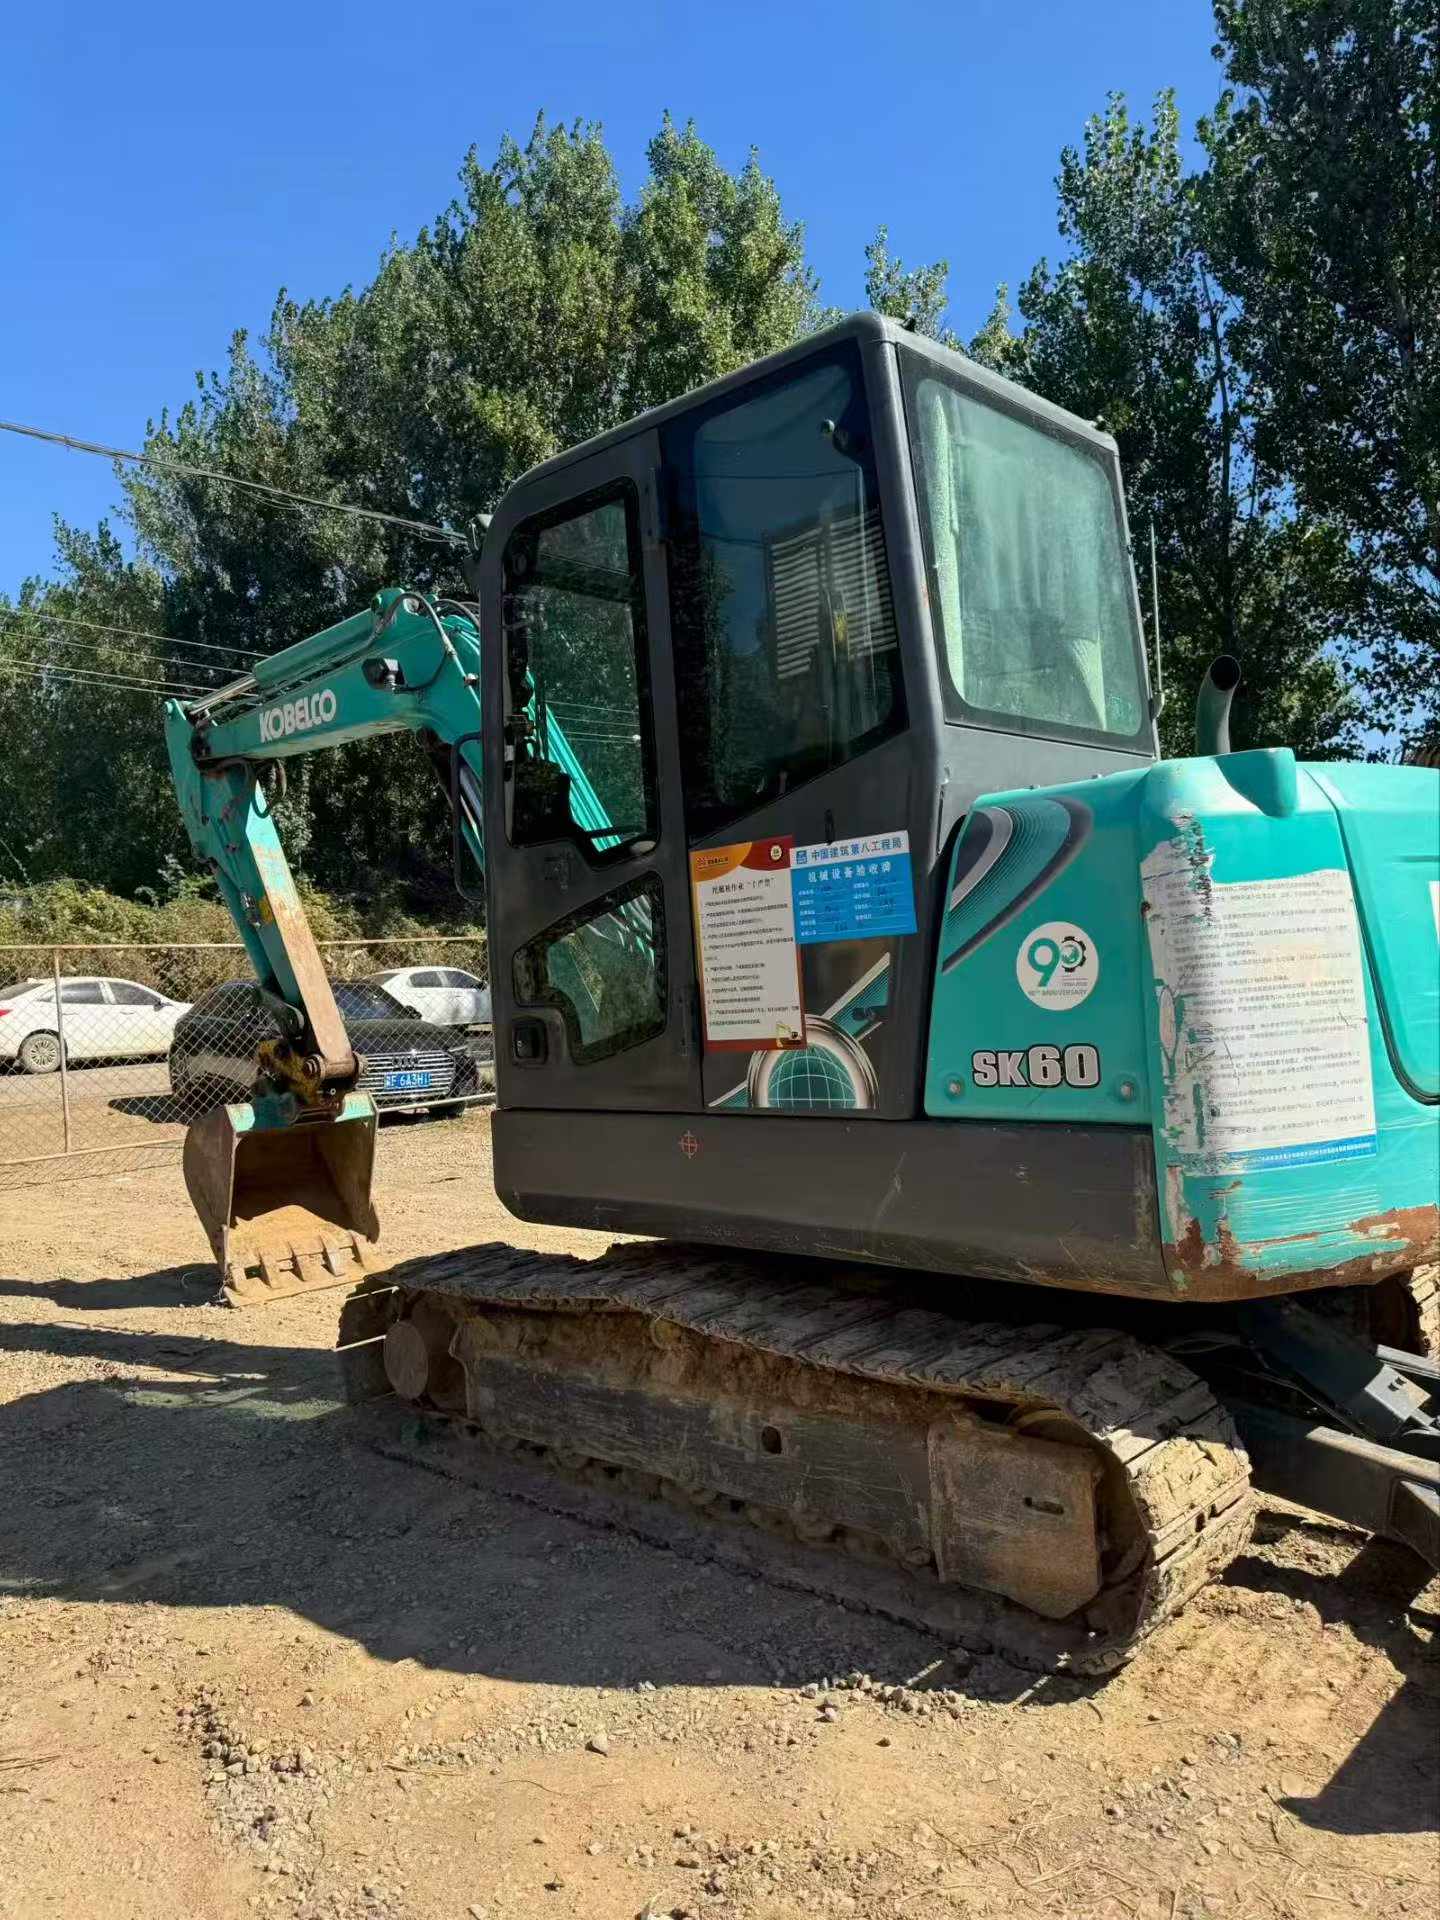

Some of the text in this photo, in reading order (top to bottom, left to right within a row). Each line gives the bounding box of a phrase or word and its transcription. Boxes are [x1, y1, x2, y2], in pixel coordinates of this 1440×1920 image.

[259, 688, 337, 744] KOBELCO
[811, 837, 902, 862] 中国建筑第八工程局
[971, 1042, 1101, 1089] SK60
